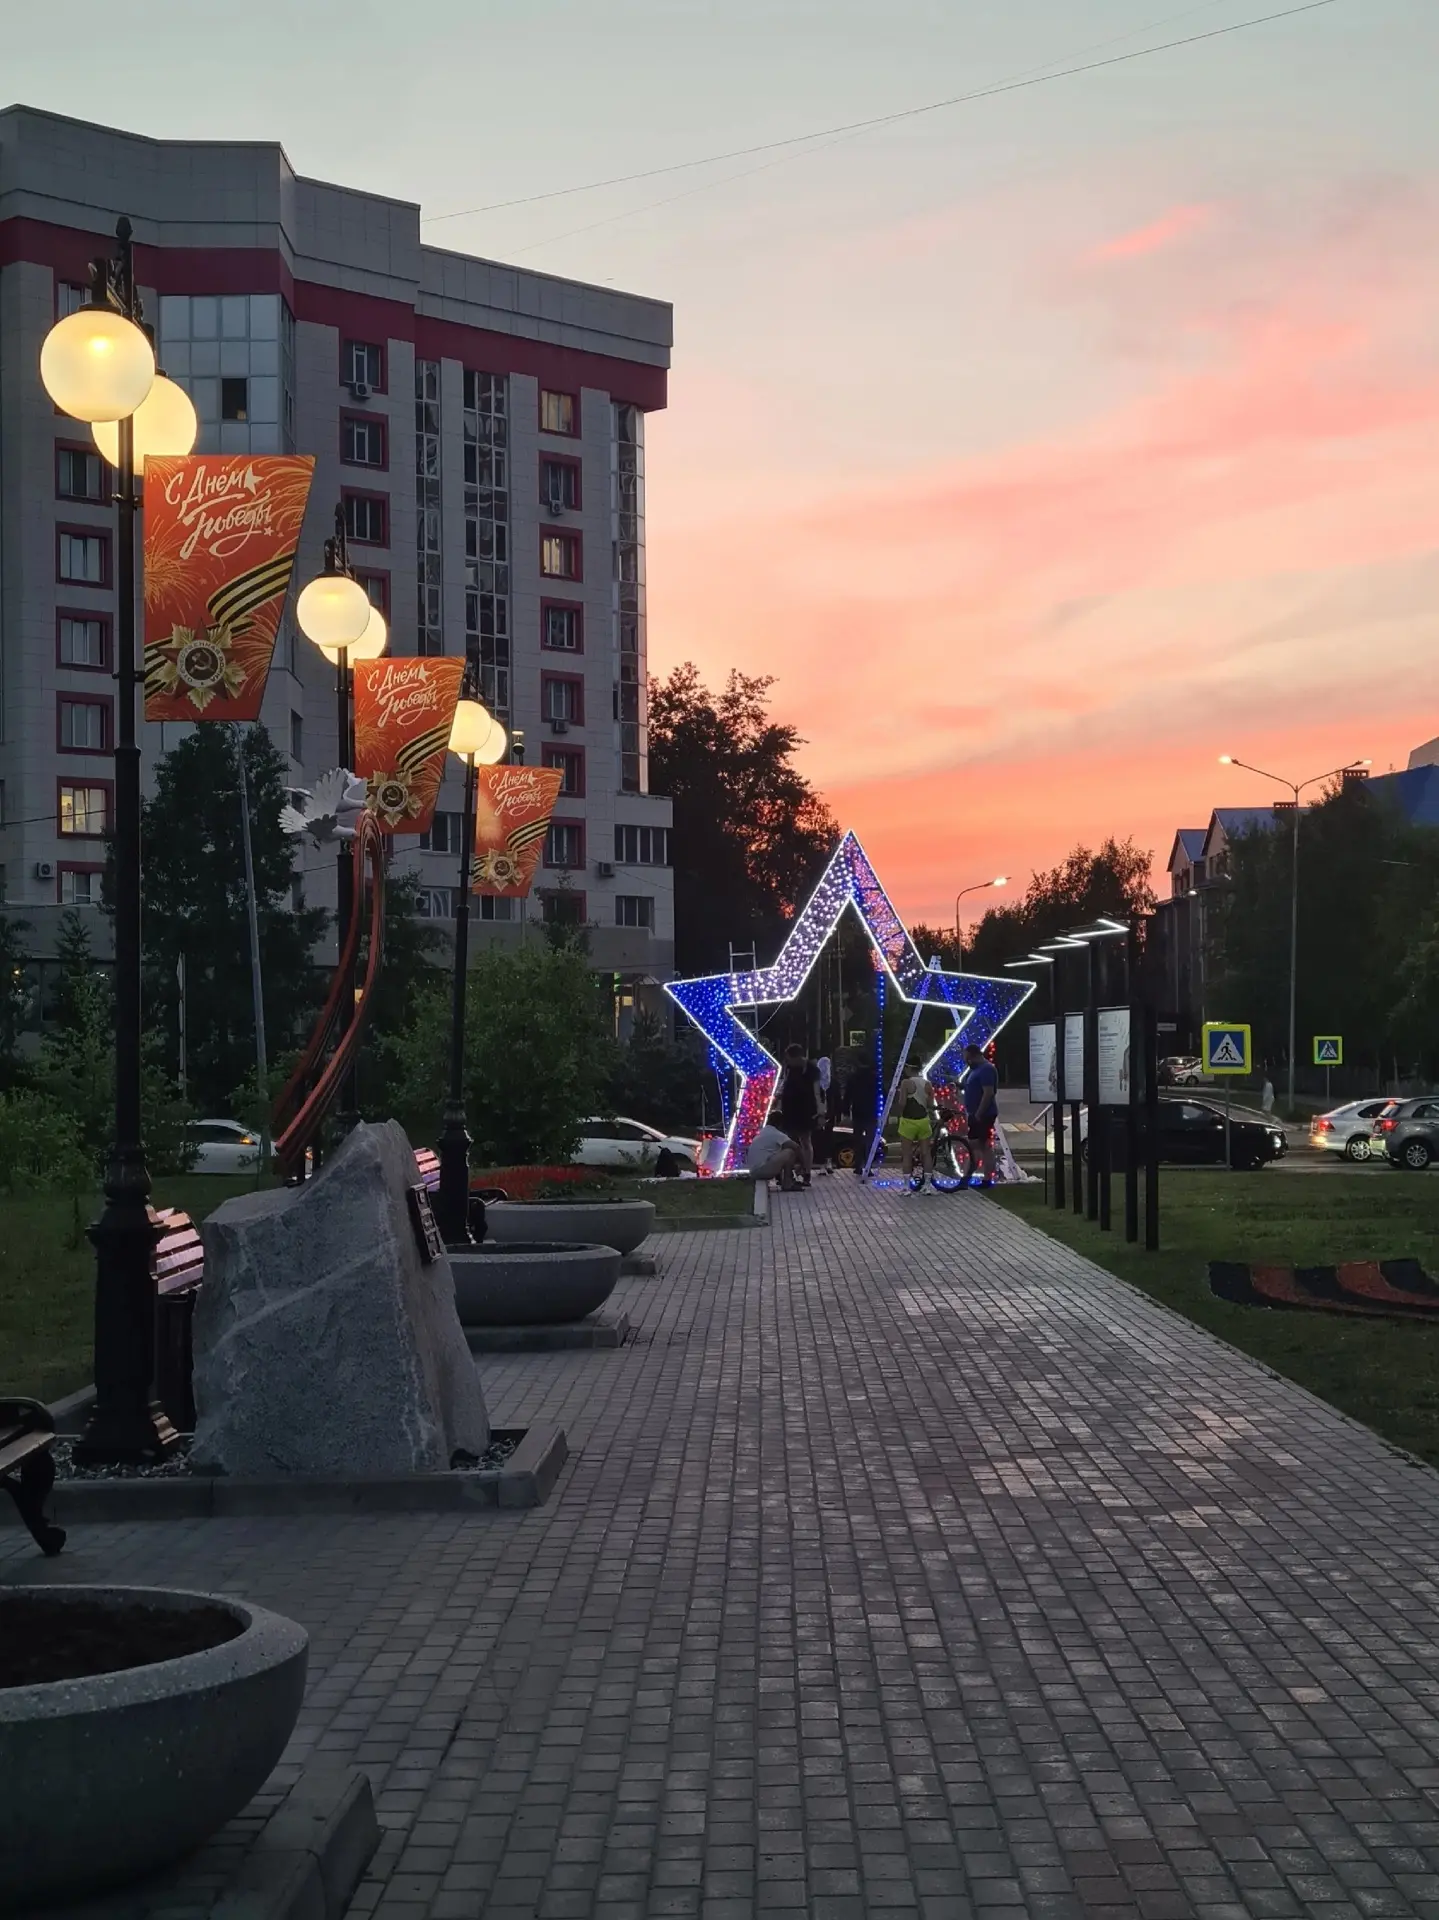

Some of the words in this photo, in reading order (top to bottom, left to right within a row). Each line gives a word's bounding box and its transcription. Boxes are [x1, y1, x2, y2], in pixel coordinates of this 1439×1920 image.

[165, 471, 184, 505] С
[177, 464, 244, 520] Днём
[179, 489, 273, 560] Победы
[367, 669, 380, 692] С
[375, 664, 420, 702] Днём
[377, 680, 437, 728] Победы
